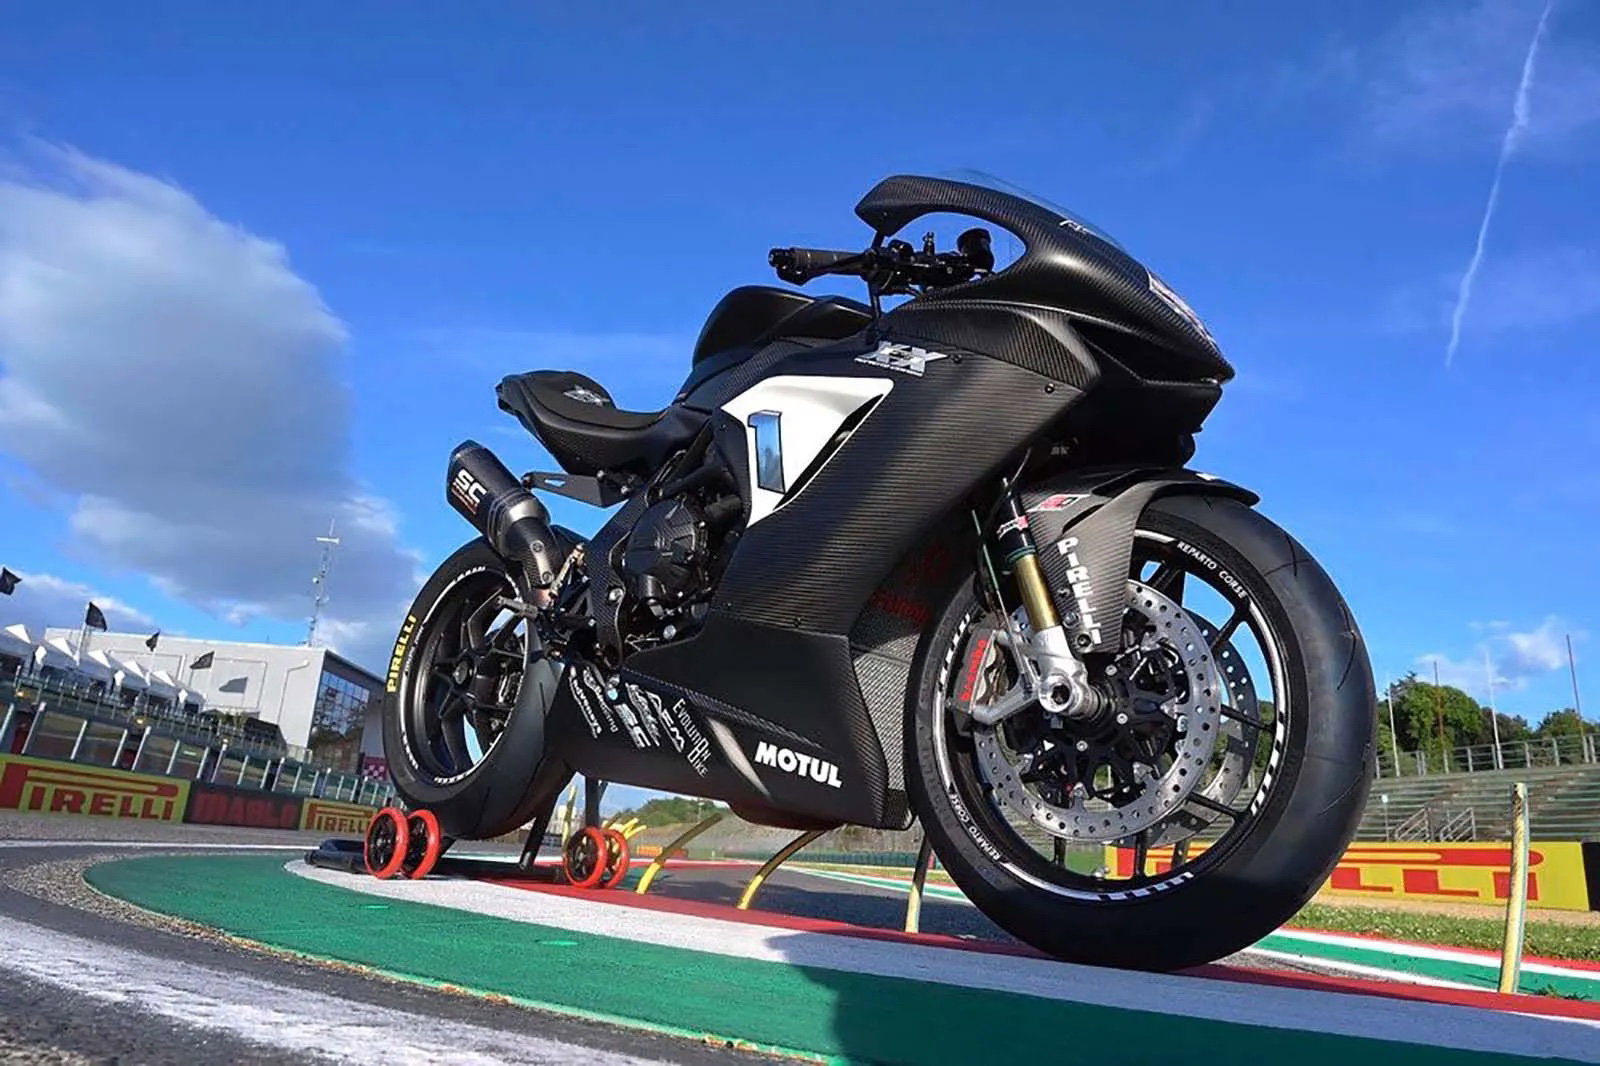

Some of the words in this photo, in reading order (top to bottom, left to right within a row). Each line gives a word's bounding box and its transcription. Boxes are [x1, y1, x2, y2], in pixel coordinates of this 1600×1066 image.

[747, 409, 786, 495] 1
[455, 469, 488, 504] SC
[1057, 536, 1102, 645] PIRELLI
[1176, 541, 1217, 570] REPARTO
[1218, 570, 1248, 599] CORSE
[386, 614, 418, 693] PIRELLI
[0, 762, 179, 820] PIRELLI
[754, 741, 843, 789] MOTUL
[305, 803, 374, 833] PIRELL
[949, 794, 970, 822] CORSE
[968, 826, 1001, 860] REPARTO
